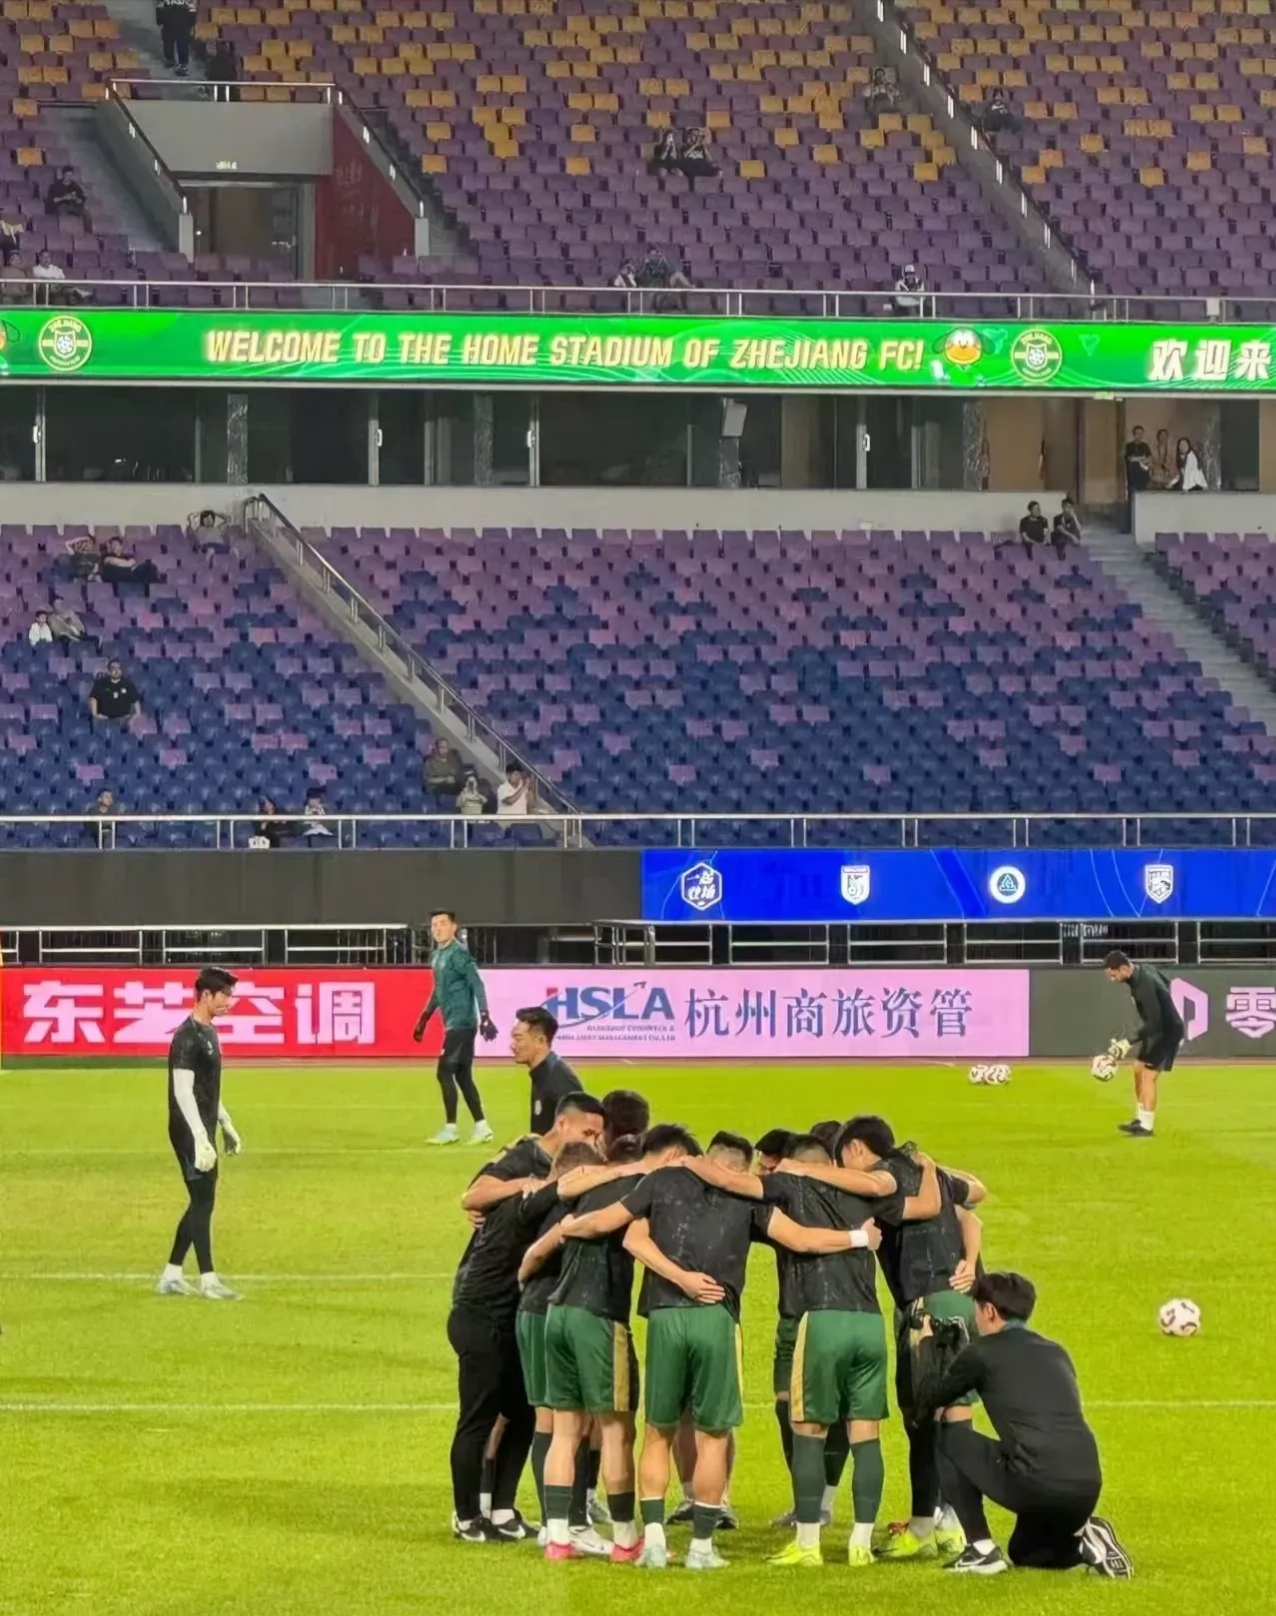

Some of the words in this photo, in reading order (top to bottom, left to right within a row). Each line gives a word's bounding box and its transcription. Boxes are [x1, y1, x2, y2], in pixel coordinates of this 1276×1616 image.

[207, 330, 341, 363] WELCOME
[352, 332, 386, 364] TO
[398, 334, 452, 365] THE
[461, 335, 540, 366] HOME
[549, 335, 674, 368] STADIUM
[682, 338, 721, 369] OF
[730, 338, 868, 370] ZHEJIANG
[878, 340, 925, 370] FC!
[1147, 338, 1272, 382] 欢迎来
[546, 986, 675, 1020] HSLA
[684, 987, 973, 1039] 杭州商旅资管
